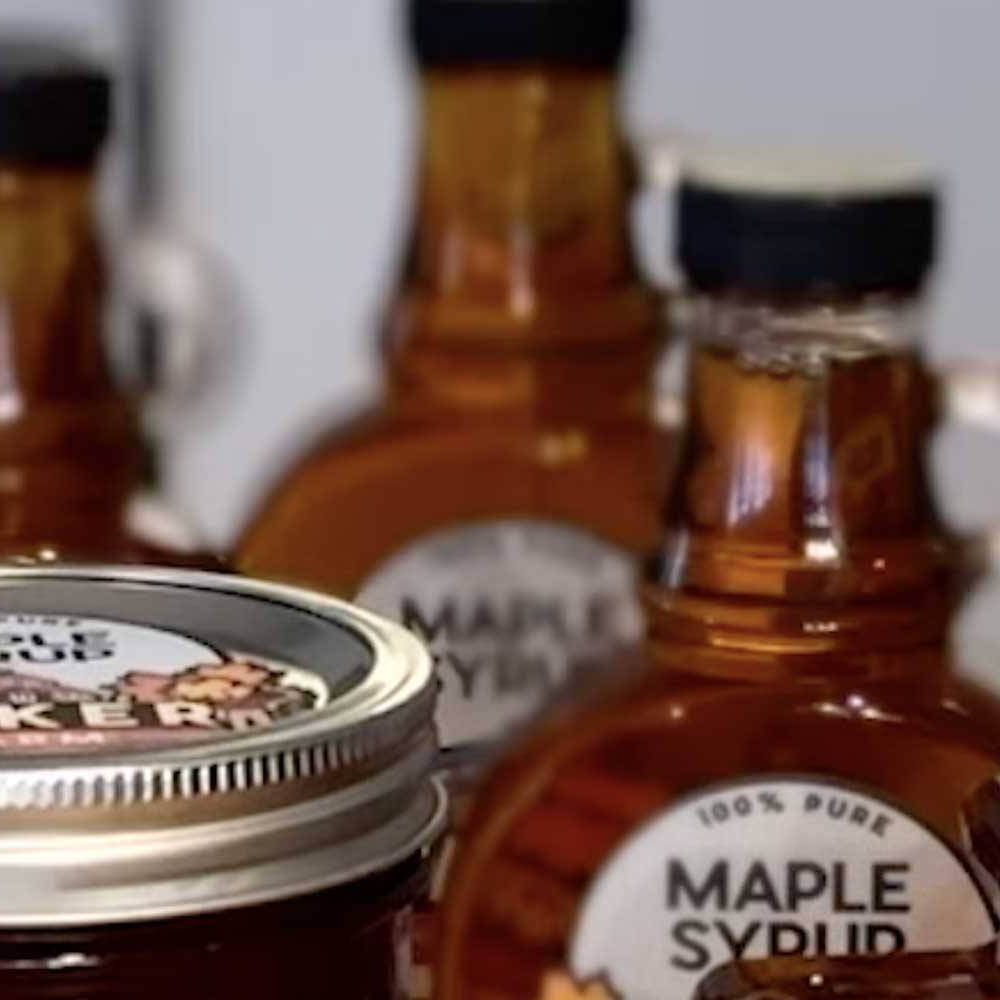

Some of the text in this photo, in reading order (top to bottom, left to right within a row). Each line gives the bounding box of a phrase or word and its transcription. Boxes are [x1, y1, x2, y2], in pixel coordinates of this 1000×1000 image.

[697, 792, 893, 838] 100% PURE
[666, 860, 911, 913] MAPLE
